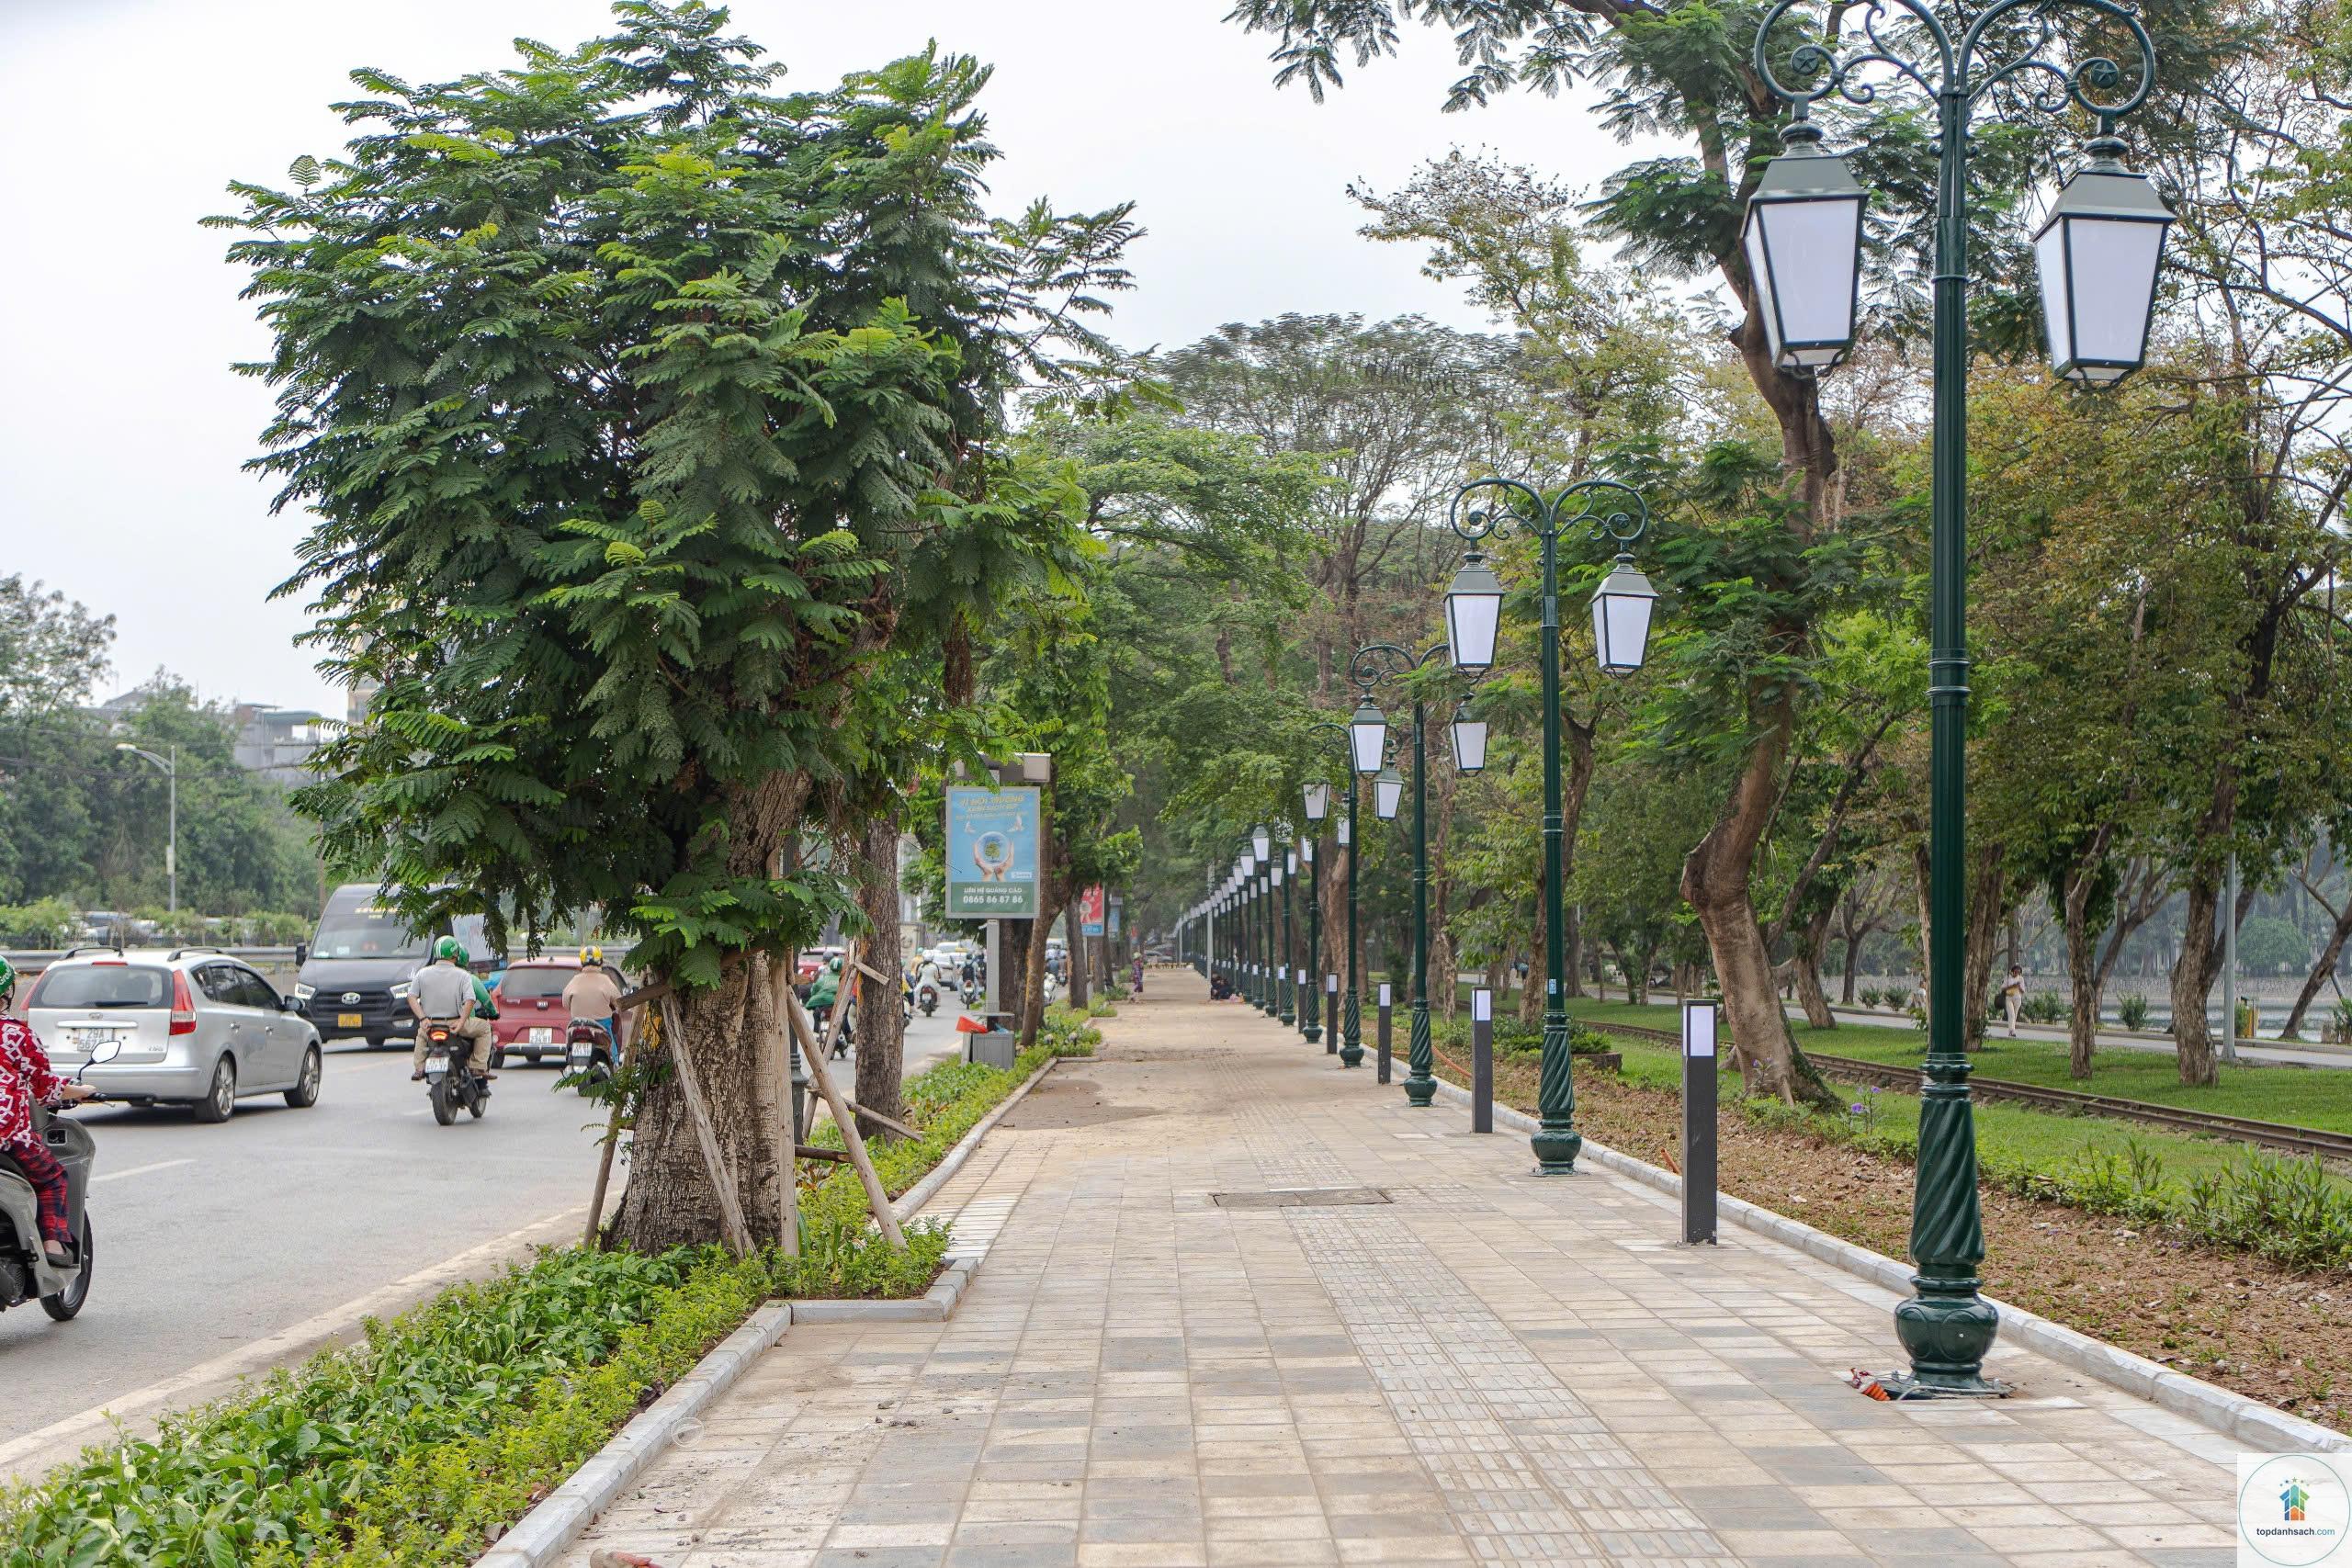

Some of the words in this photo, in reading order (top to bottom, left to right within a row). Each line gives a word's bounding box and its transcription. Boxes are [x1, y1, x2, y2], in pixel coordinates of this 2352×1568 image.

[963, 896, 984, 904] 0865
[986, 896, 997, 904] 86
[1000, 896, 1010, 904] 87
[1012, 896, 1023, 904] 86
[87, 1029, 104, 1038] 29A
